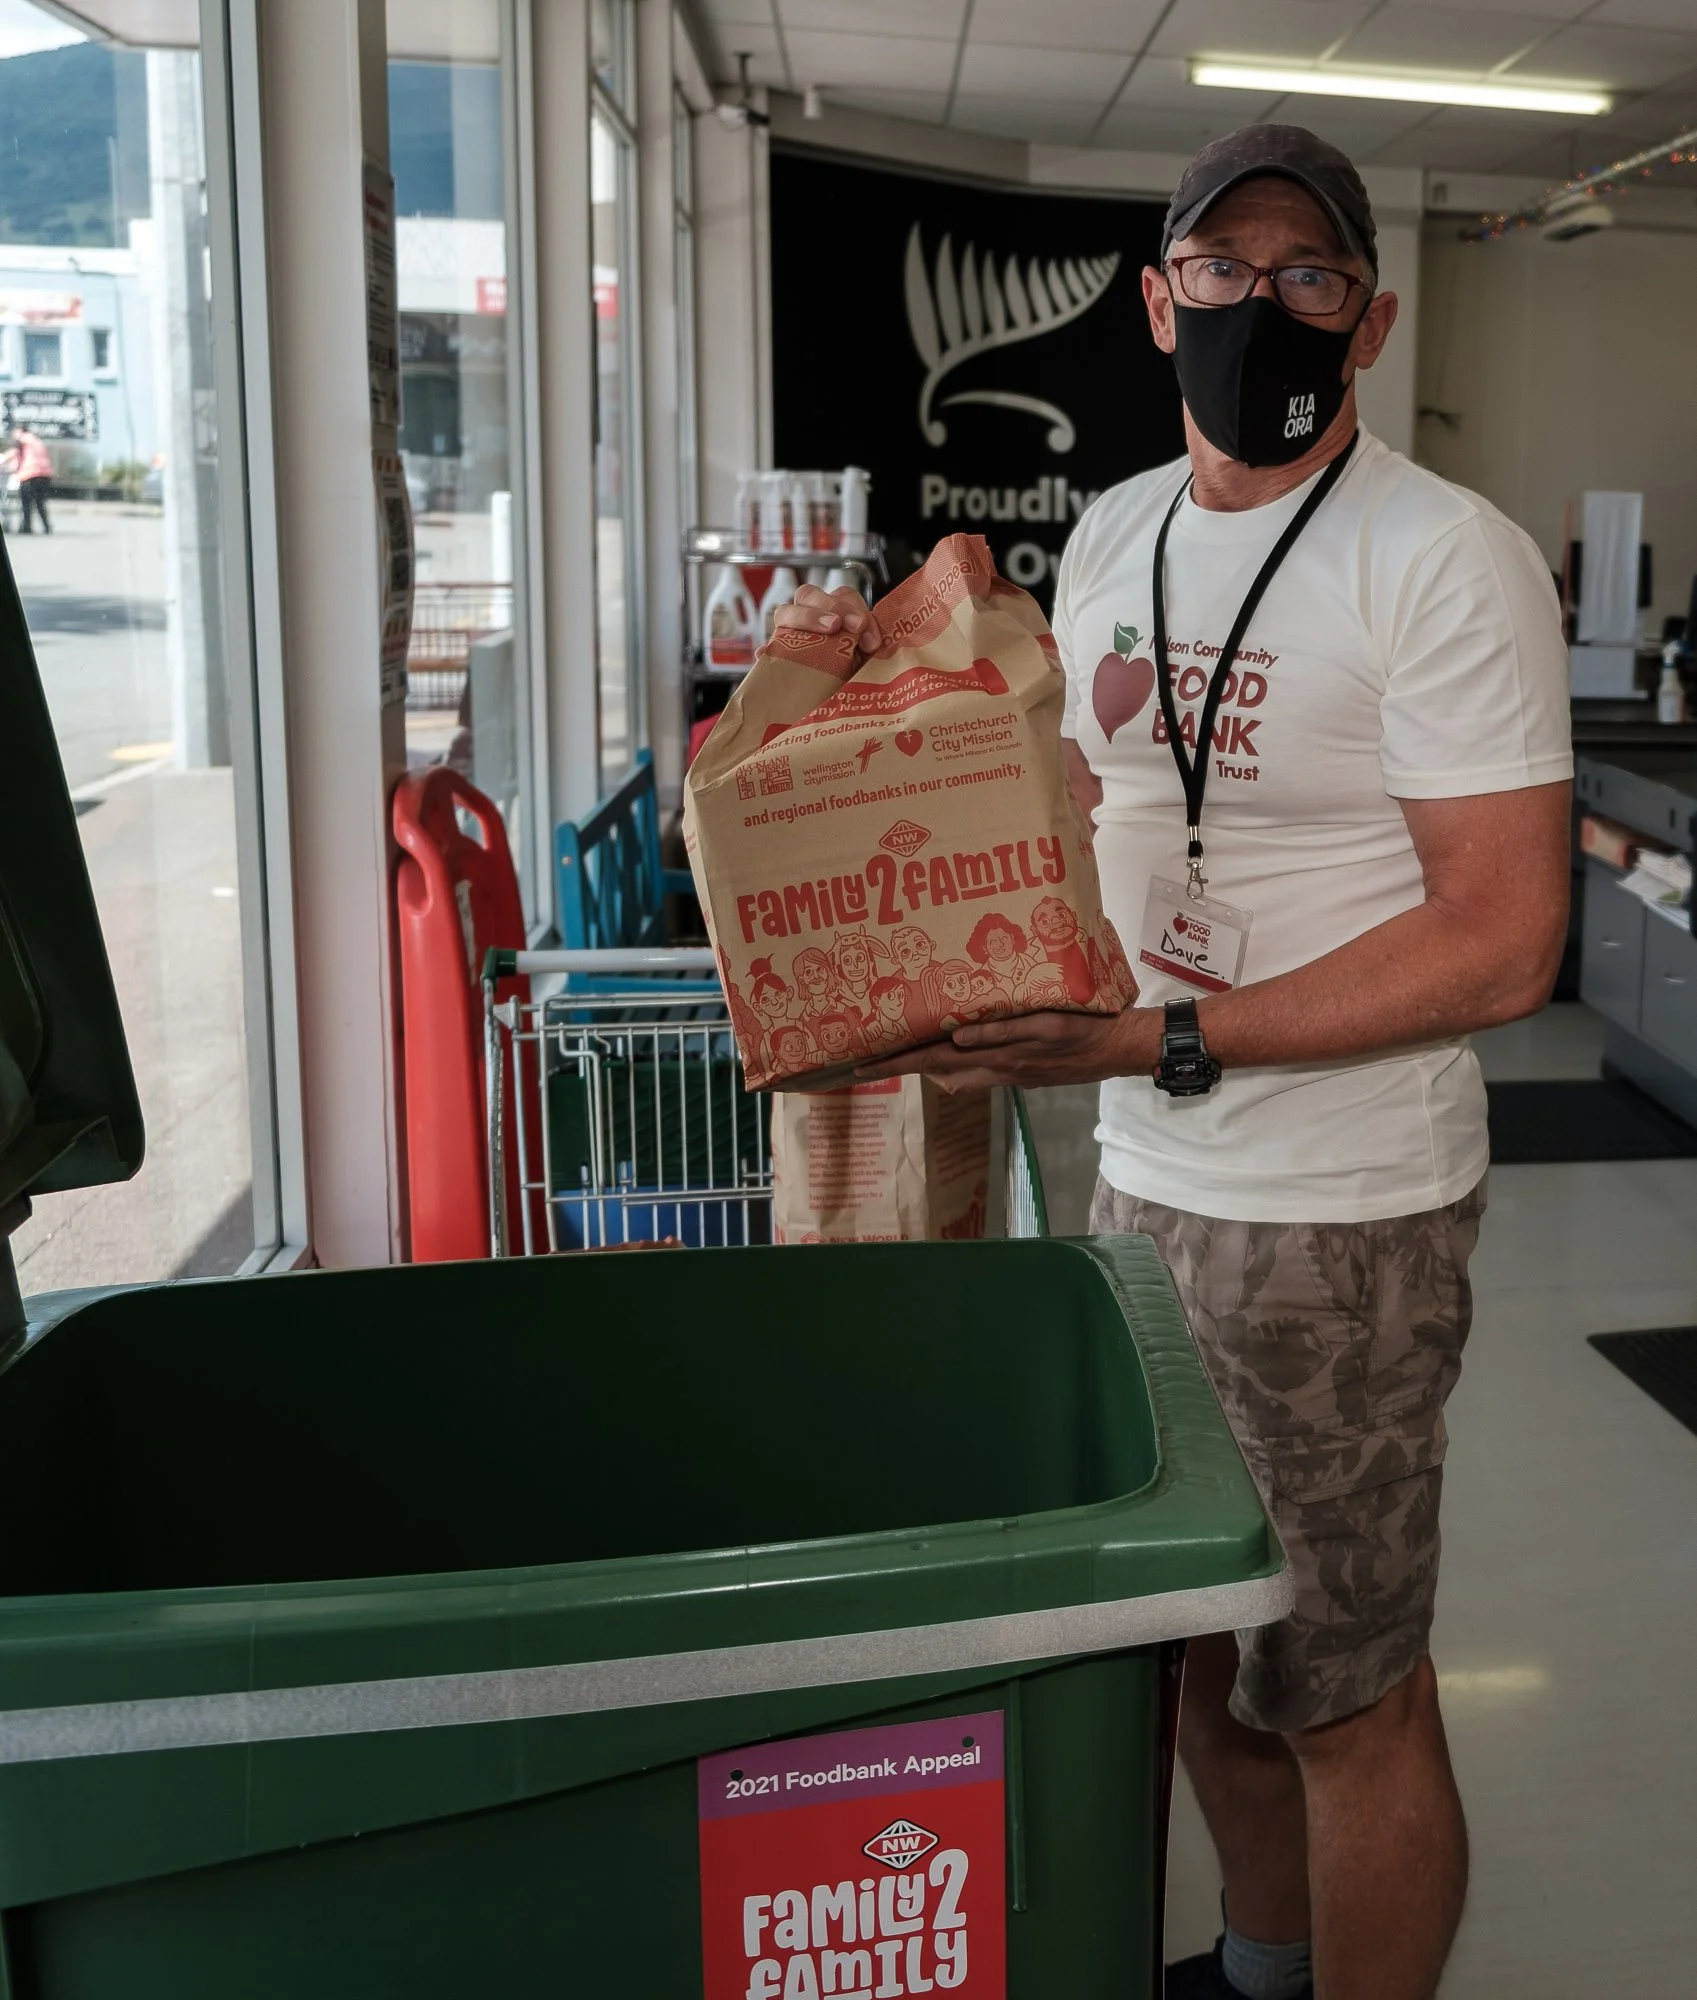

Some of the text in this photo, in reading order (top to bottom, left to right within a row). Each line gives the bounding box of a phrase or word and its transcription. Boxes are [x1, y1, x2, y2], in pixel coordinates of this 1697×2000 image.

[1288, 393, 1315, 418] KIA
[1284, 414, 1313, 438] ORA
[881, 595, 938, 648] odbank
[932, 559, 977, 600] Appeal
[1193, 640, 1280, 669] Comunity
[831, 692, 856, 703] rop
[860, 691, 885, 701] off
[888, 677, 917, 700] your
[840, 702, 874, 712] New
[877, 688, 919, 710] World
[814, 719, 886, 738] foodbanks
[929, 712, 1018, 738] Christchurch
[1152, 709, 1263, 757] BANK
[932, 730, 1013, 752] City Mission
[803, 760, 854, 777] wellington
[804, 769, 856, 786] citymission
[1216, 760, 1260, 781] Trust
[744, 763, 1027, 828] and regional foodbanks in our community.
[892, 831, 919, 845] NW
[1187, 931, 1209, 945] BANK
[1189, 922, 1211, 936] FOOD
[726, 1746, 981, 1799] 2021 Foodbank Appeal
[882, 1835, 921, 1853] NW
